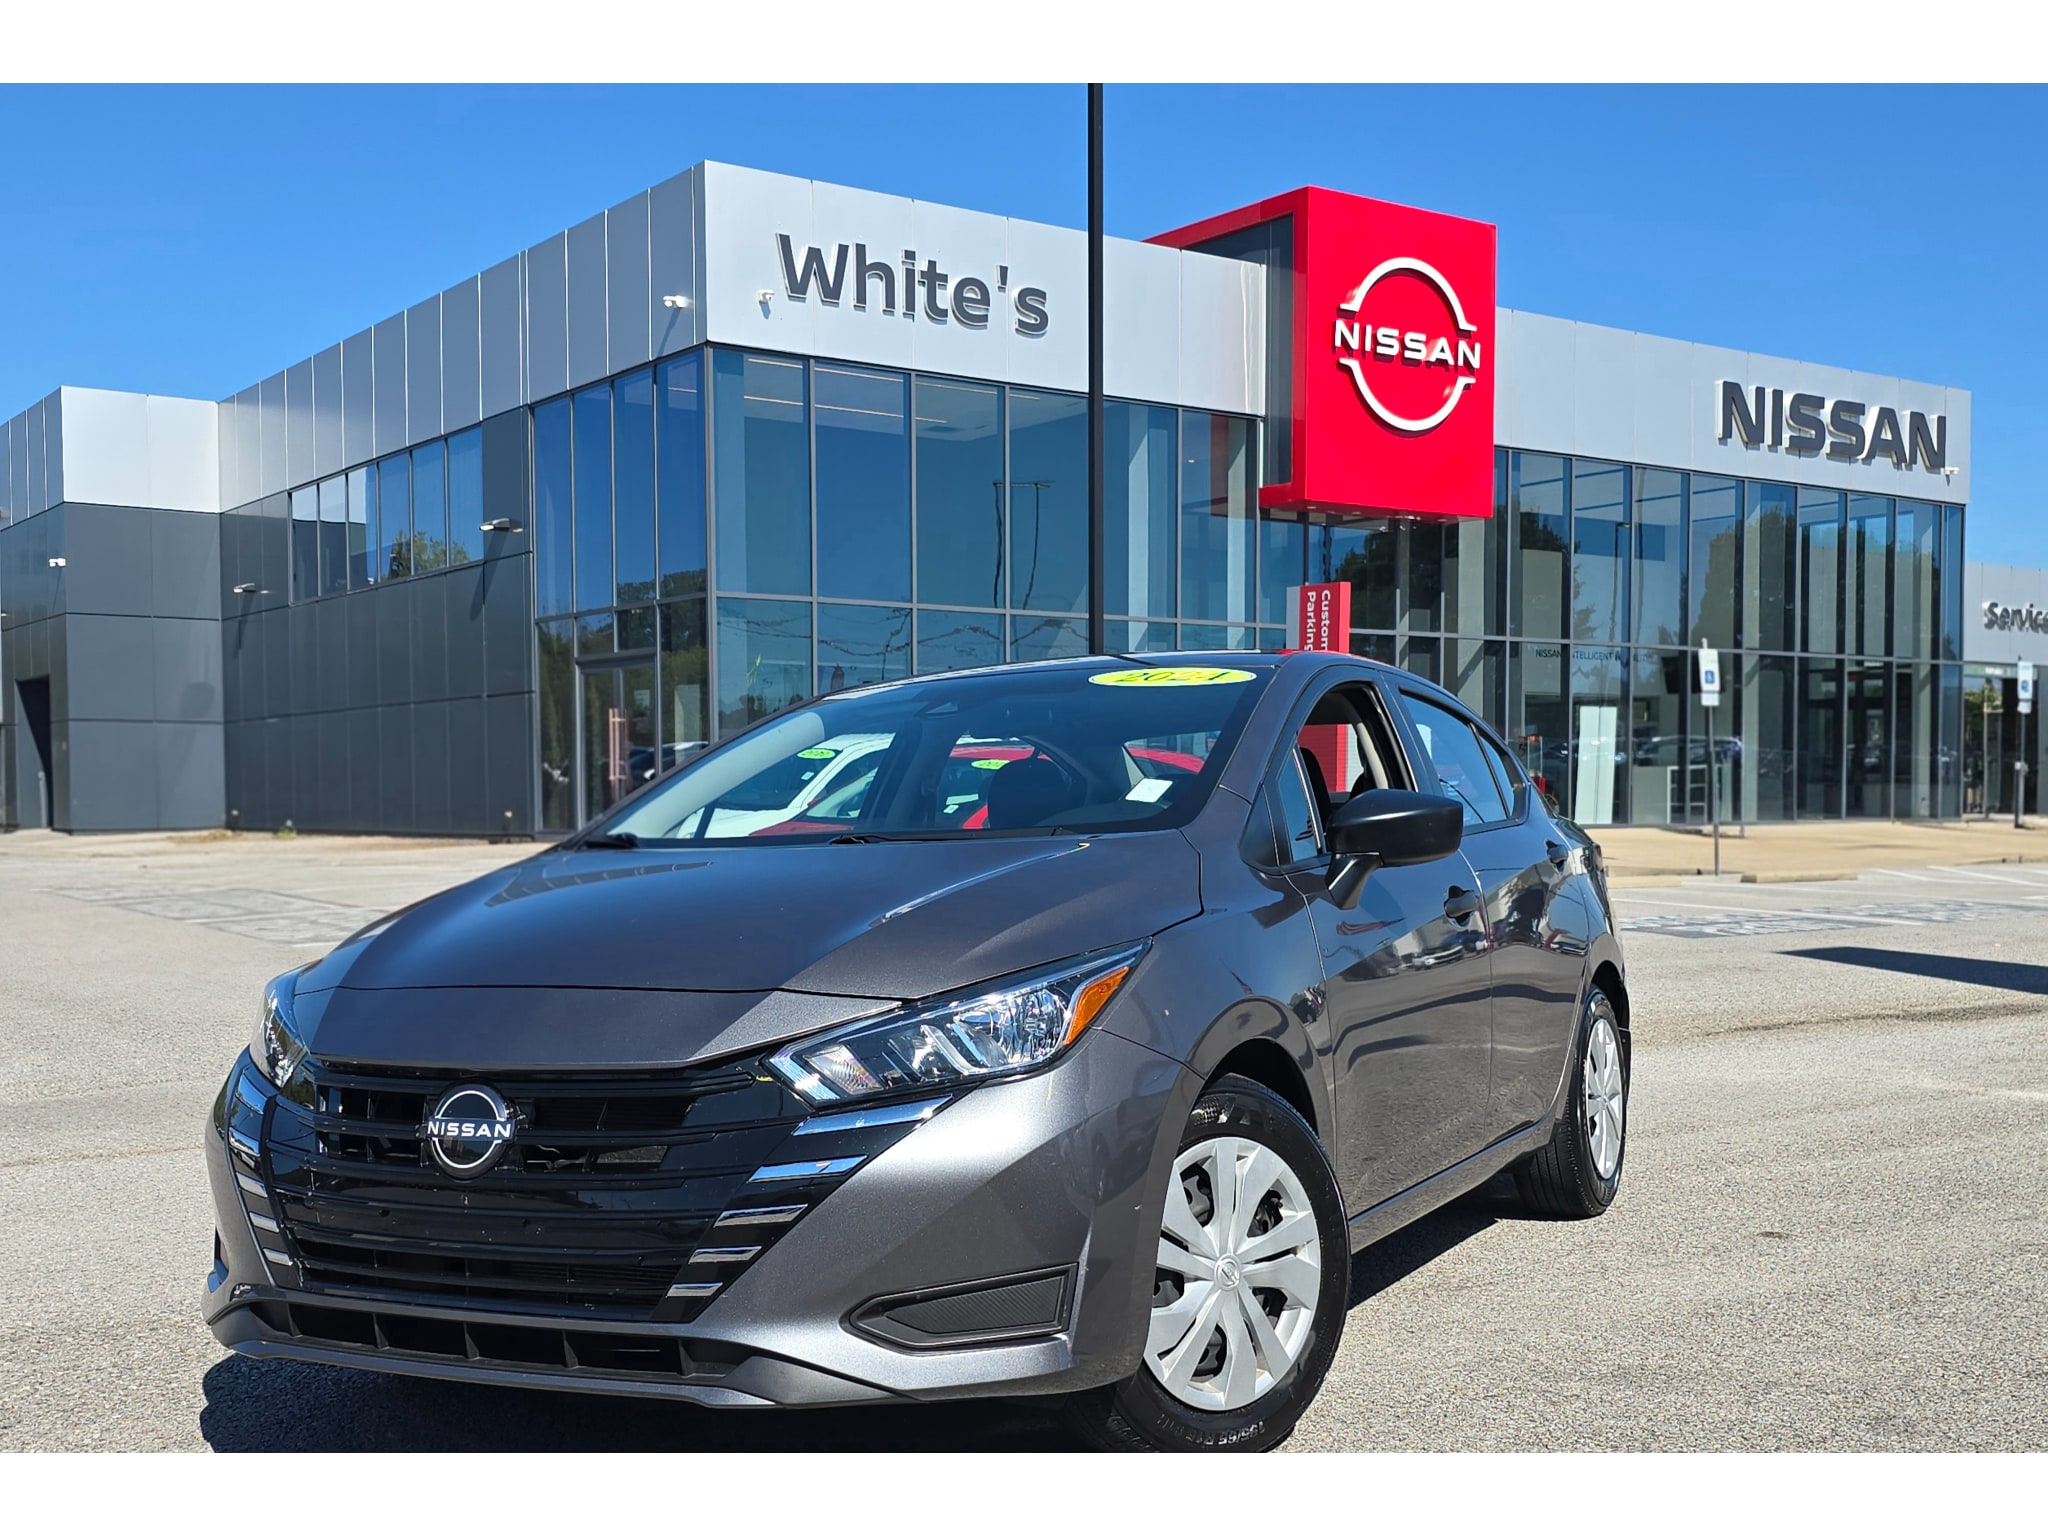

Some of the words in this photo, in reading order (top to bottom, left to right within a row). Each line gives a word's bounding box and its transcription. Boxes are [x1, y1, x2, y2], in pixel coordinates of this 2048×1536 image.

[776, 232, 1050, 335] White's
[1334, 319, 1482, 370] NISSAN
[1716, 379, 1948, 470] NISSAN
[427, 1120, 512, 1138] NISSAN
